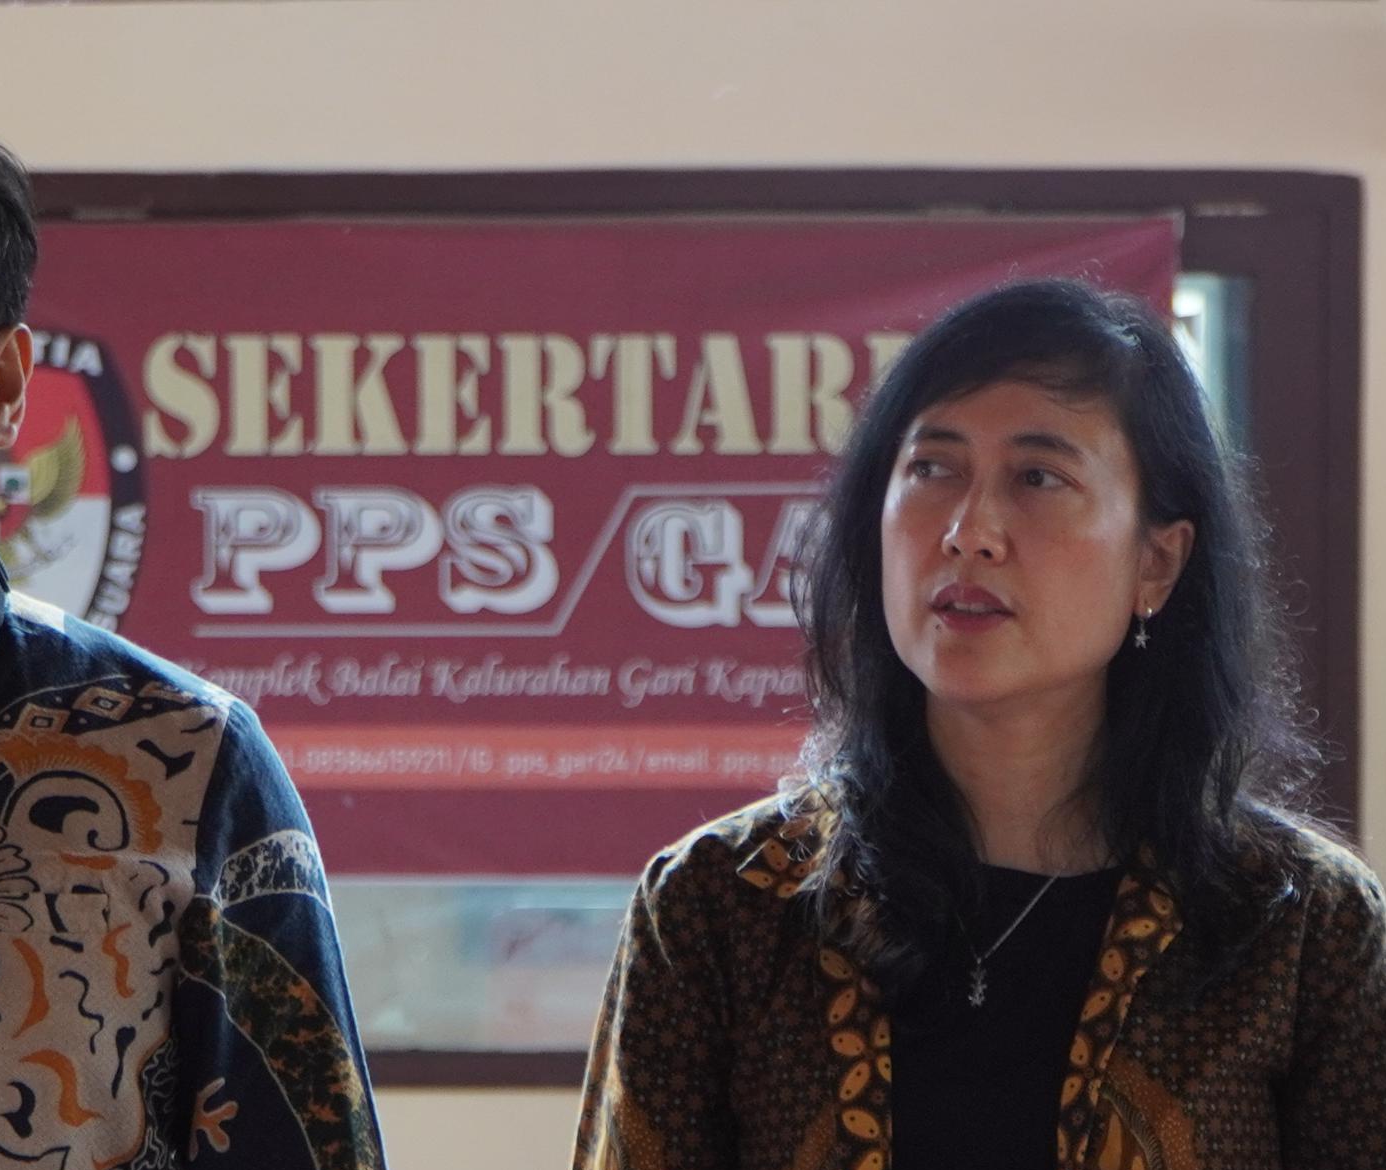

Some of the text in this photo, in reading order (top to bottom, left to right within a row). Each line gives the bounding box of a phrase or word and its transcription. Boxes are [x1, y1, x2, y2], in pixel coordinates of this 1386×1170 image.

[331, 654, 426, 696] Balai
[429, 653, 611, 703] Kalurahan
[617, 656, 698, 708] Gari
[705, 657, 809, 707] Kapa
